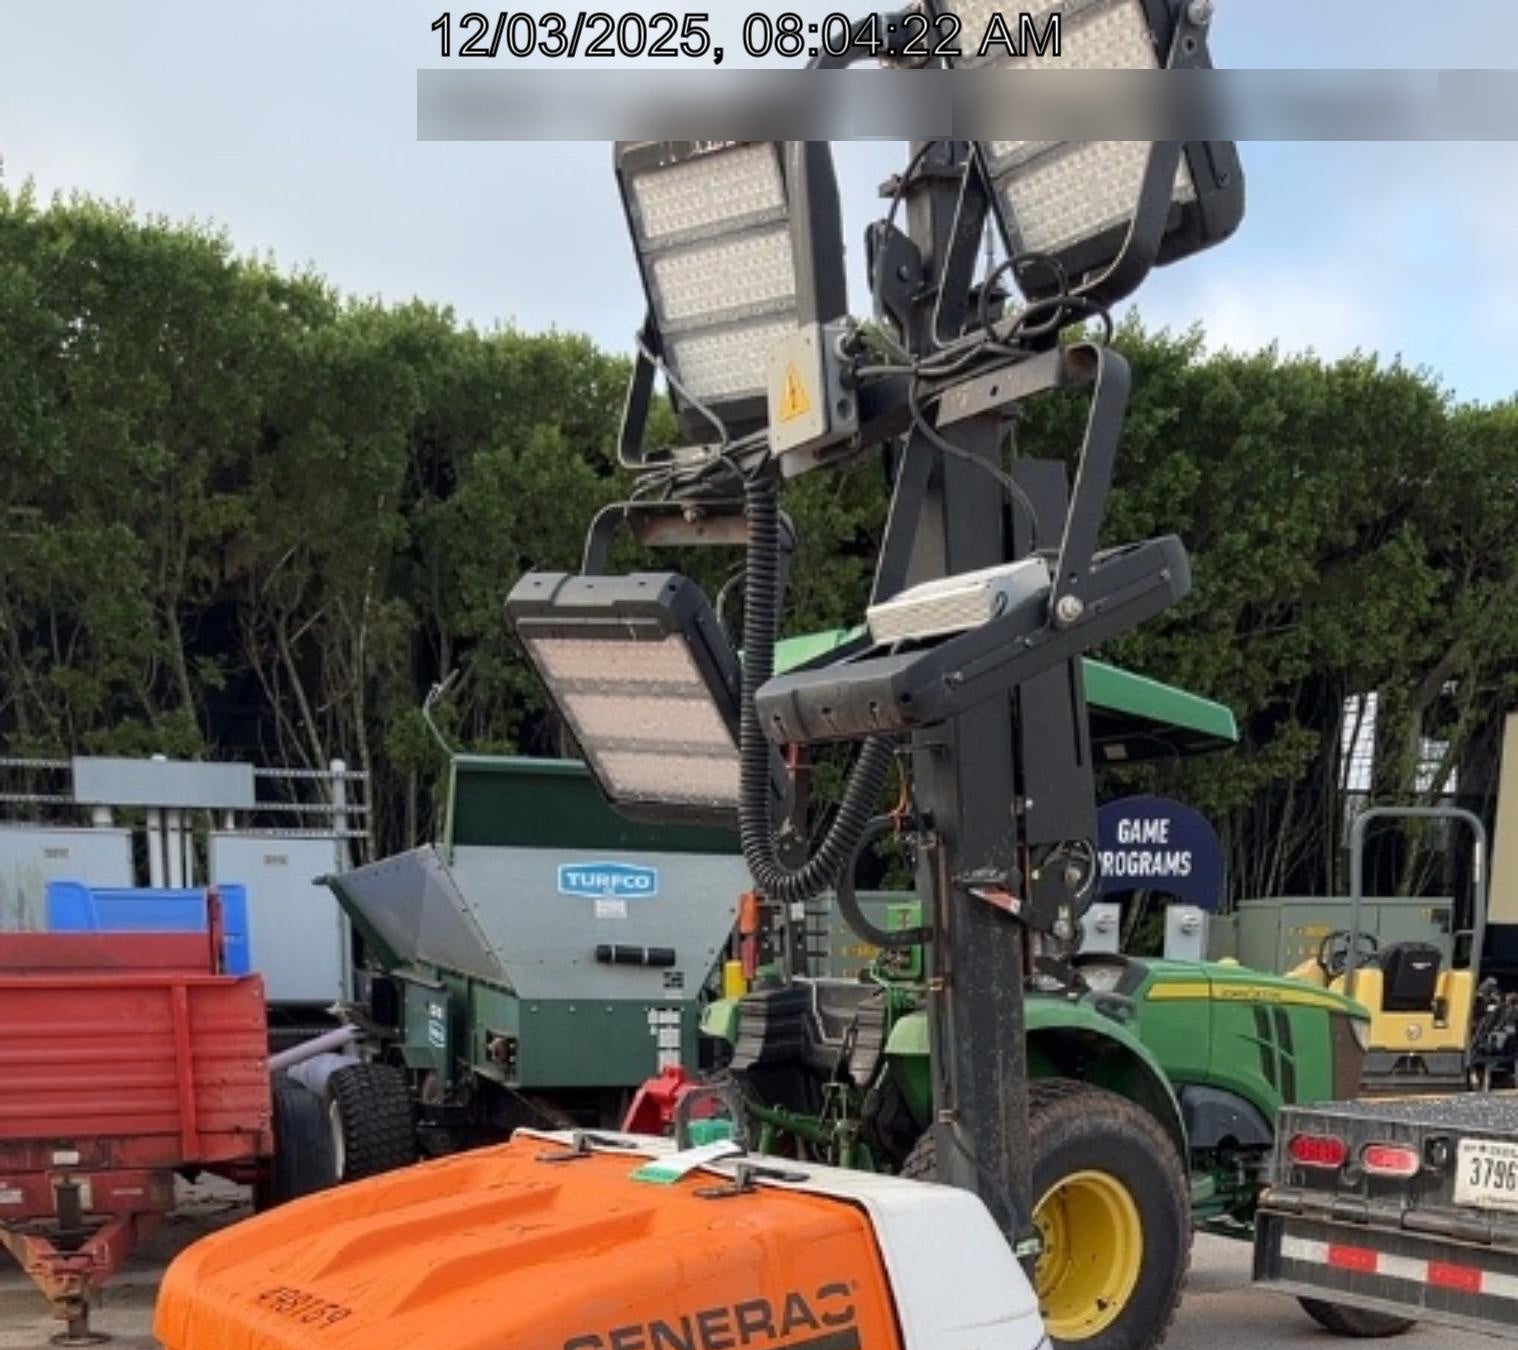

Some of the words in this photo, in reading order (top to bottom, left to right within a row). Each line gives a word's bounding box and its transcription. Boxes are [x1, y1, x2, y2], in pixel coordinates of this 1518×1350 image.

[1118, 818, 1170, 844] GAME
[1098, 851, 1192, 877] ROGRAMS
[566, 872, 650, 888] TURFCO
